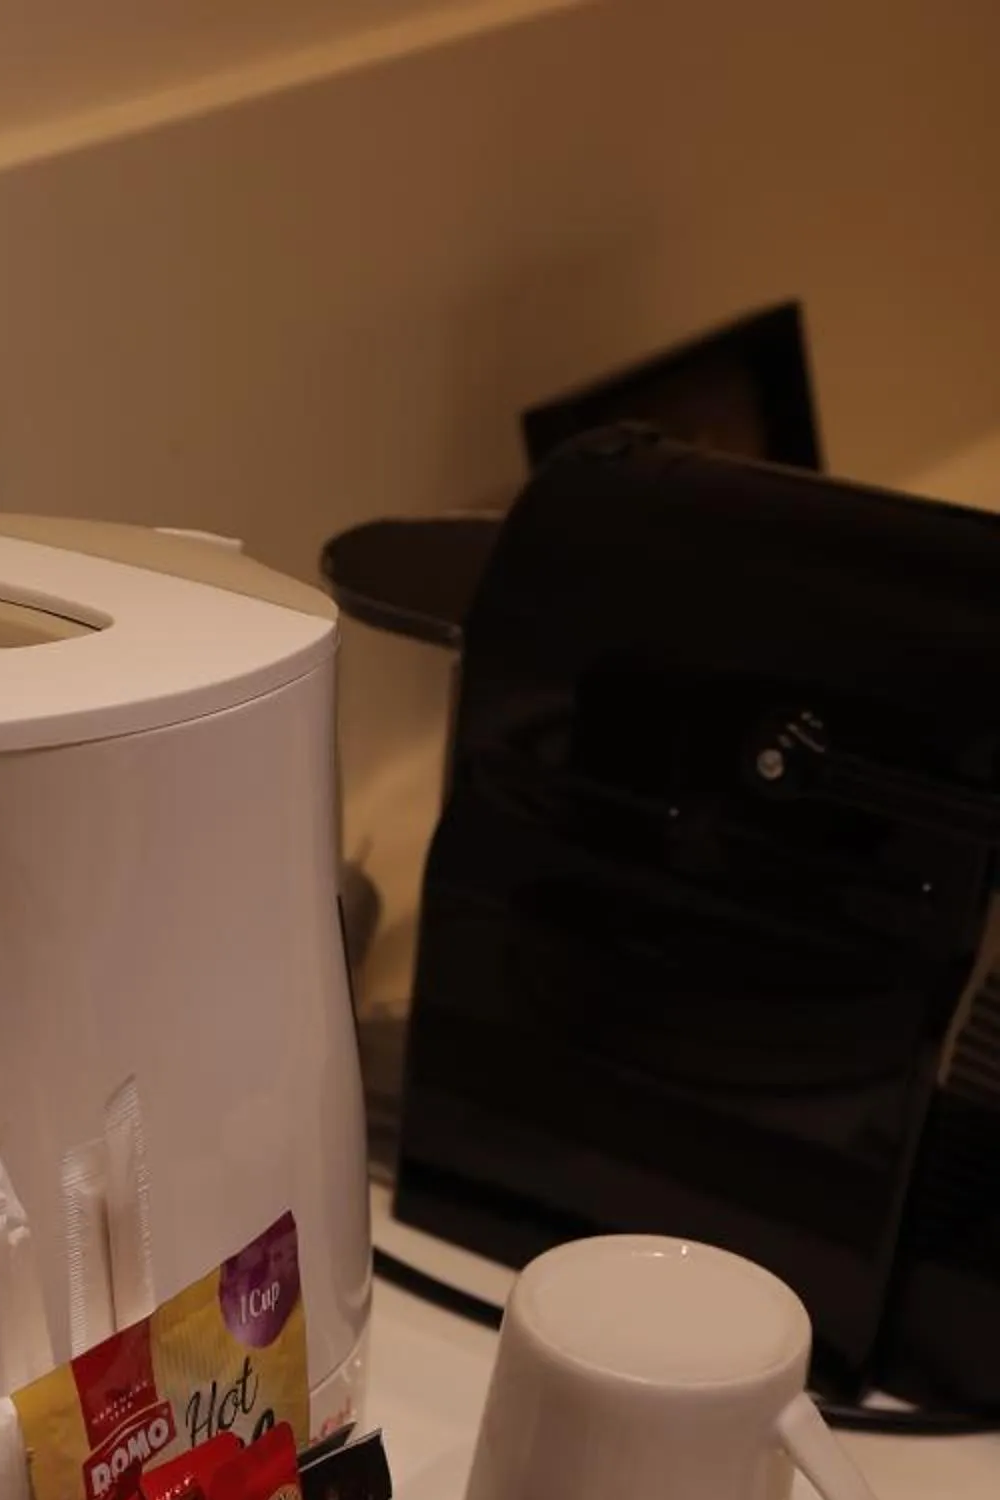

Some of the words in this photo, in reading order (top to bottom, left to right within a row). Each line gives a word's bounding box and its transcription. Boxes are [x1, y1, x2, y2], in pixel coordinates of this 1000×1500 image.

[239, 1294, 247, 1325] 1
[249, 1279, 280, 1318] Cup
[185, 1356, 260, 1447] Hot
